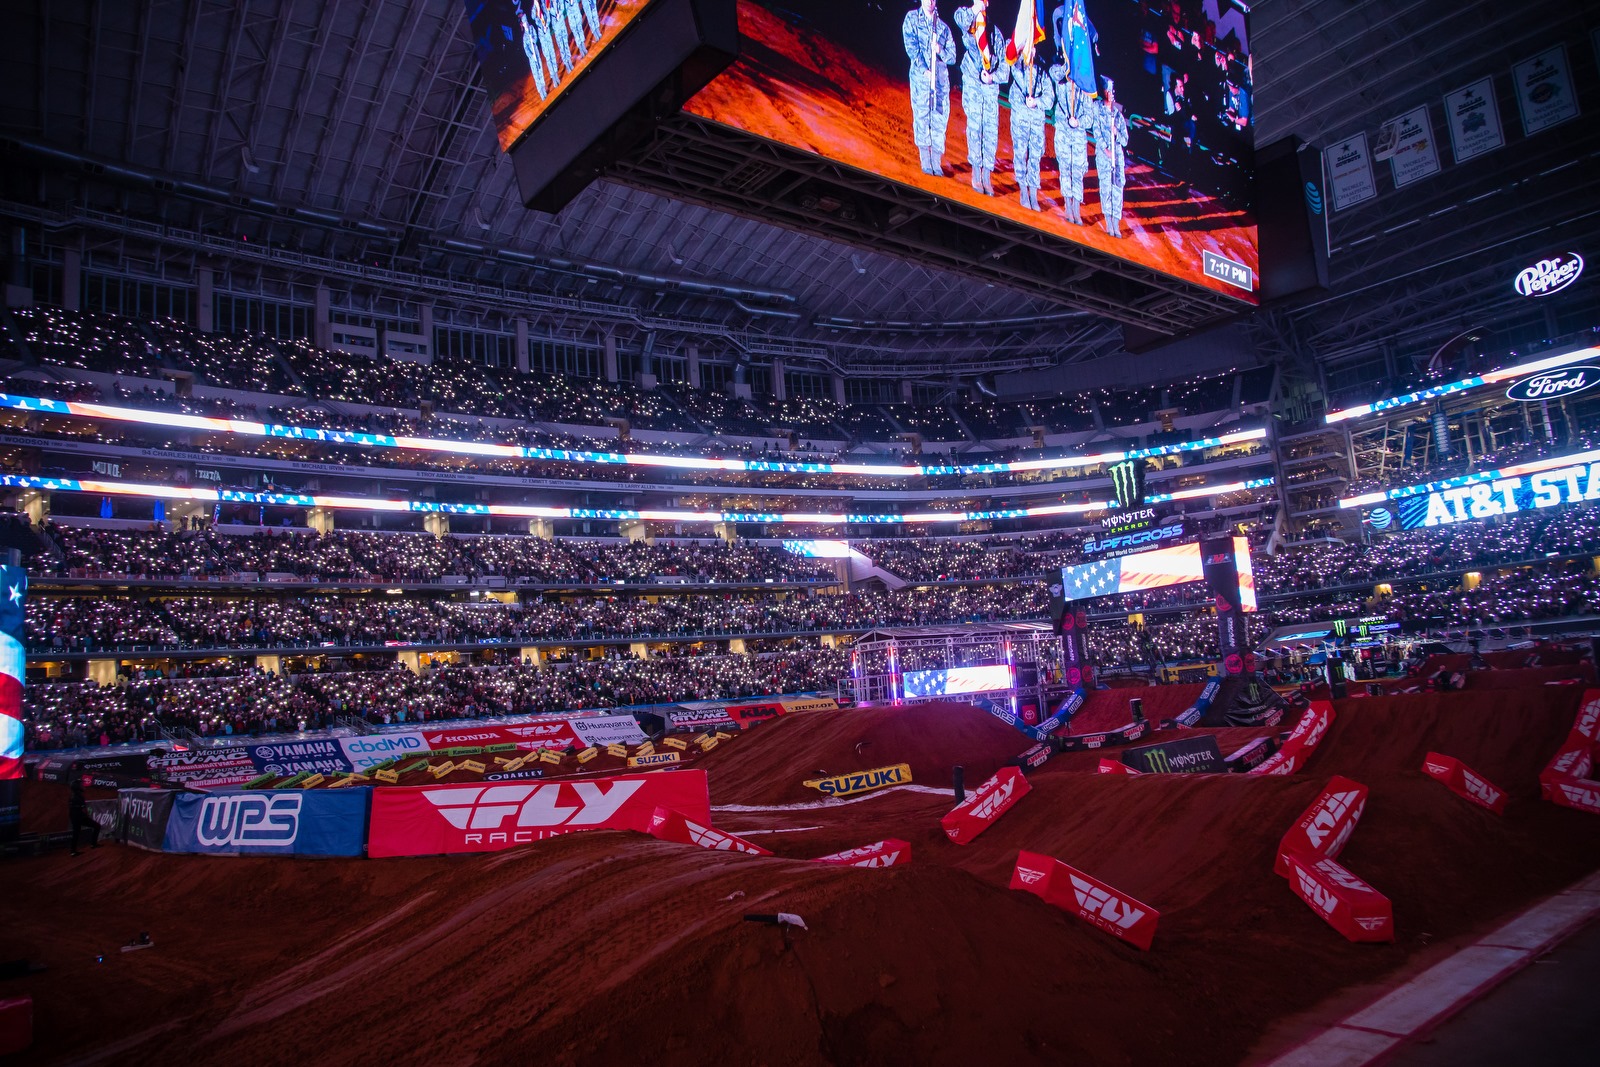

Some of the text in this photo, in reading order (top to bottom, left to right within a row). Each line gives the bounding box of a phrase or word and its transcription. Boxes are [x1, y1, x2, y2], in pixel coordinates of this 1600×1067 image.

[1527, 103, 1573, 125] CHAMPIONS
[1534, 100, 1563, 114] WORLD
[1458, 133, 1499, 152] CHAMPIONS
[1464, 129, 1490, 142] WORLD
[1336, 154, 1360, 168] COWBOYS
[1337, 150, 1357, 162] DALLAS
[1402, 156, 1427, 169] WORLD
[1398, 160, 1435, 178] CHAMPIONS
[1337, 185, 1372, 202] CHAMPIONS
[1342, 181, 1364, 193] WORLD
[1210, 258, 1247, 284] 7:17 PM
[1535, 257, 1561, 279] Dr
[1515, 259, 1579, 296] Pepper
[1526, 371, 1586, 398] Ford
[4, 436, 50, 446] WOODSON
[152, 450, 187, 459] CHARLES
[187, 453, 211, 461] HALEY
[301, 463, 328, 471] MICHAEL
[1424, 477, 1522, 527] AT&T
[1101, 507, 1156, 529] MONSTER
[1111, 520, 1150, 534] ENERGY
[1083, 523, 1185, 555] SUPERCROSS
[1115, 549, 1129, 558] World
[1128, 543, 1159, 555] Championship
[740, 706, 778, 720] KTM
[795, 703, 834, 711] DUNLOP
[991, 703, 1016, 726] WPS
[504, 724, 565, 737] FLY
[587, 721, 633, 730] Husqvarna
[348, 736, 421, 753] cbdMD
[445, 731, 501, 743] HONDA
[163, 746, 246, 759] ROCKY MOUNTAIN
[273, 741, 337, 757] YAMAHA
[490, 744, 516, 752] Kawasaki
[281, 759, 346, 773] YAMAHA
[636, 753, 676, 765] SUZUKI
[1168, 750, 1215, 769] MONSTER
[205, 765, 254, 775] MOUNTAIN
[502, 770, 543, 780] OAKLEY
[93, 779, 118, 787] TOYOTA
[819, 767, 902, 796] SUZUKI
[1463, 769, 1501, 806] FLY
[421, 780, 647, 830] FLY
[968, 775, 1016, 818] FLY
[1300, 792, 1331, 829] RACING
[1305, 789, 1361, 849] FLY
[197, 793, 303, 847] WPS
[464, 829, 592, 846] RACIN
[1294, 865, 1339, 914] FLY
[1069, 873, 1147, 929] FLY
[1079, 909, 1124, 937] RACING
